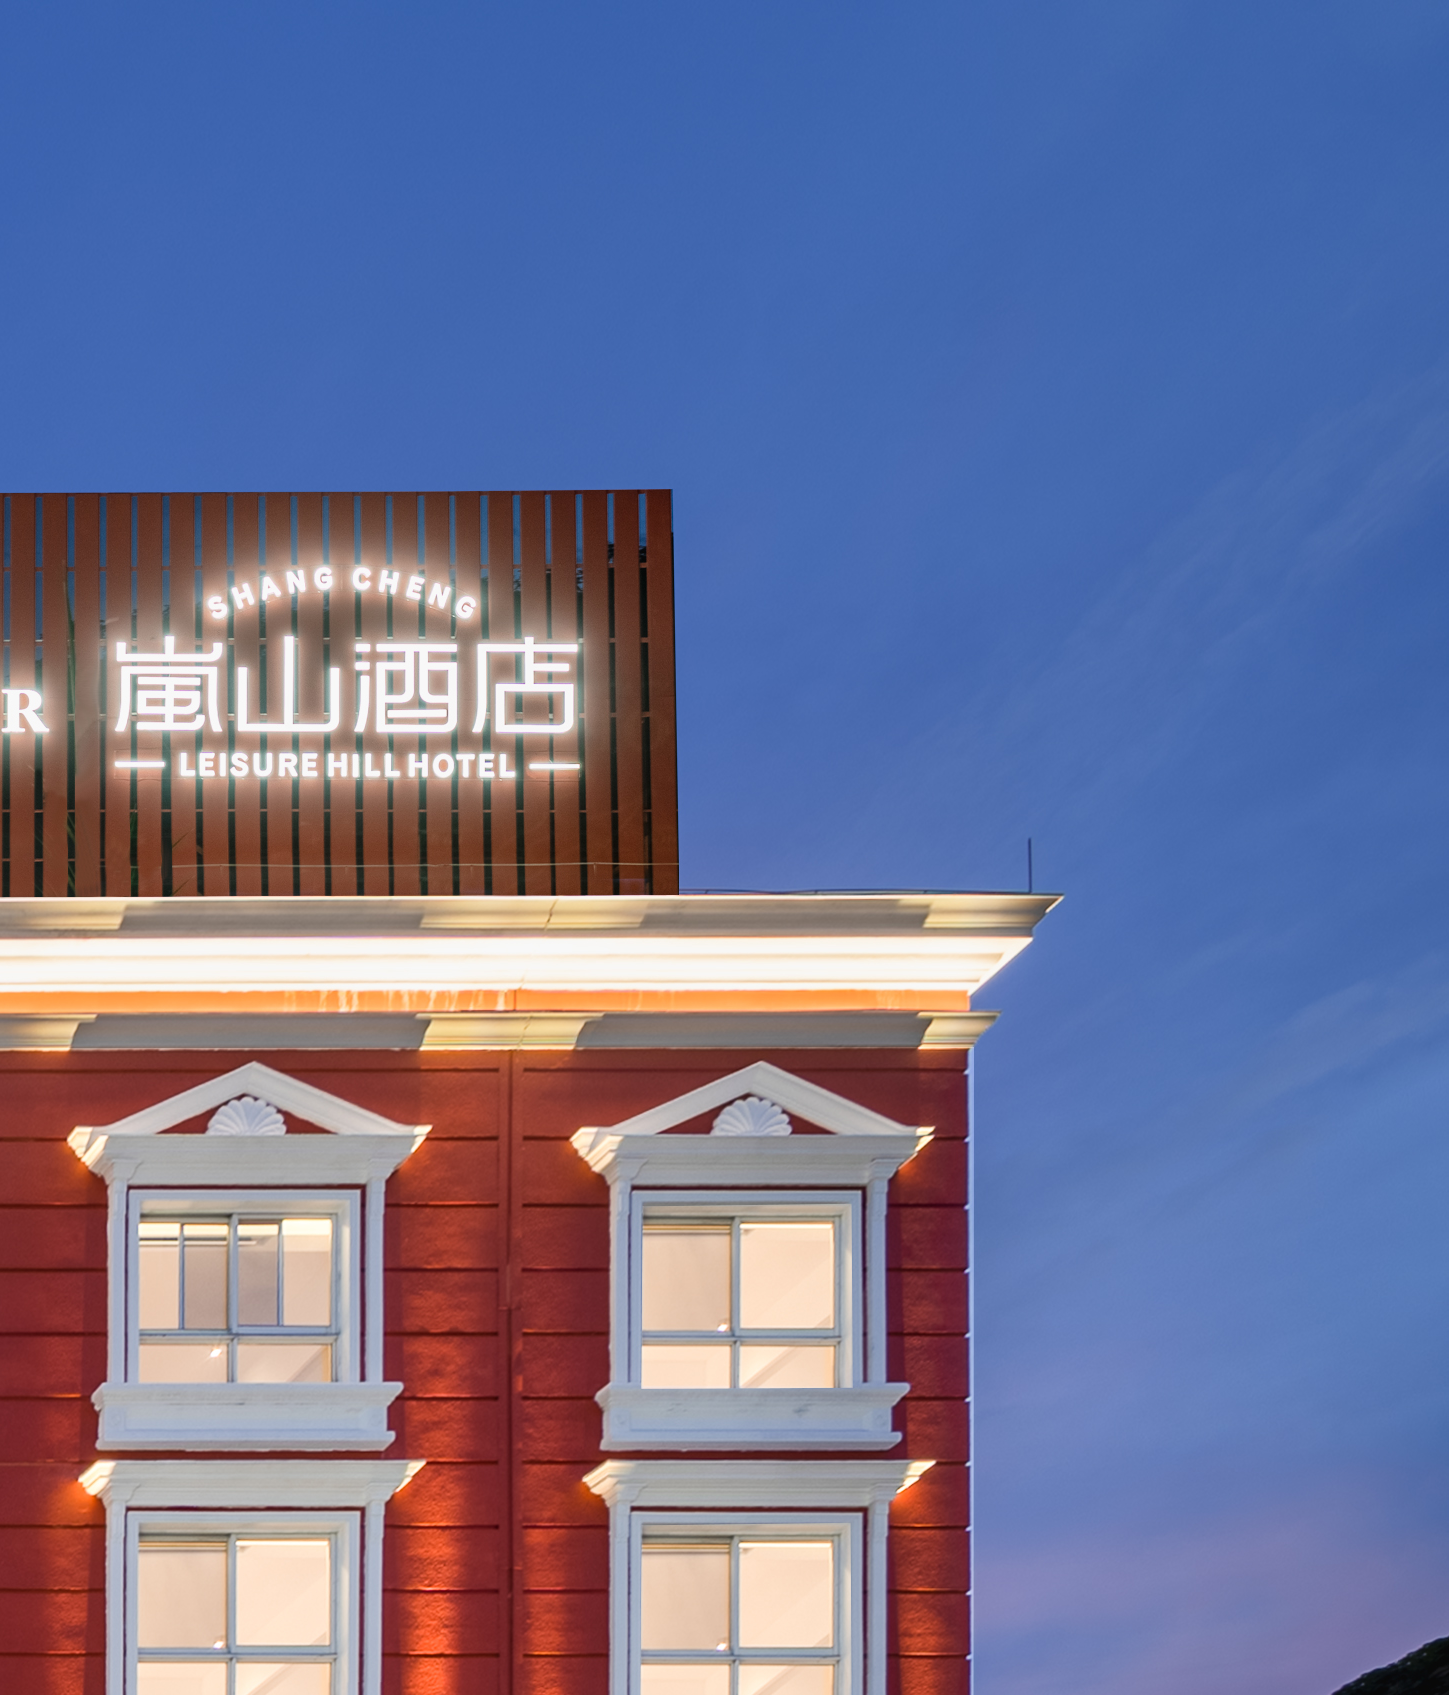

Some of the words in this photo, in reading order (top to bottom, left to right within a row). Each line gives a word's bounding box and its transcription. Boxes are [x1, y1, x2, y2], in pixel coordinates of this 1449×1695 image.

[208, 566, 334, 620] SHANG
[352, 566, 478, 620] CHENG
[114, 635, 579, 733] 嵐山酒店
[180, 751, 318, 778] LEISURE
[327, 751, 400, 778] HILL
[409, 752, 516, 779] HOTEL
